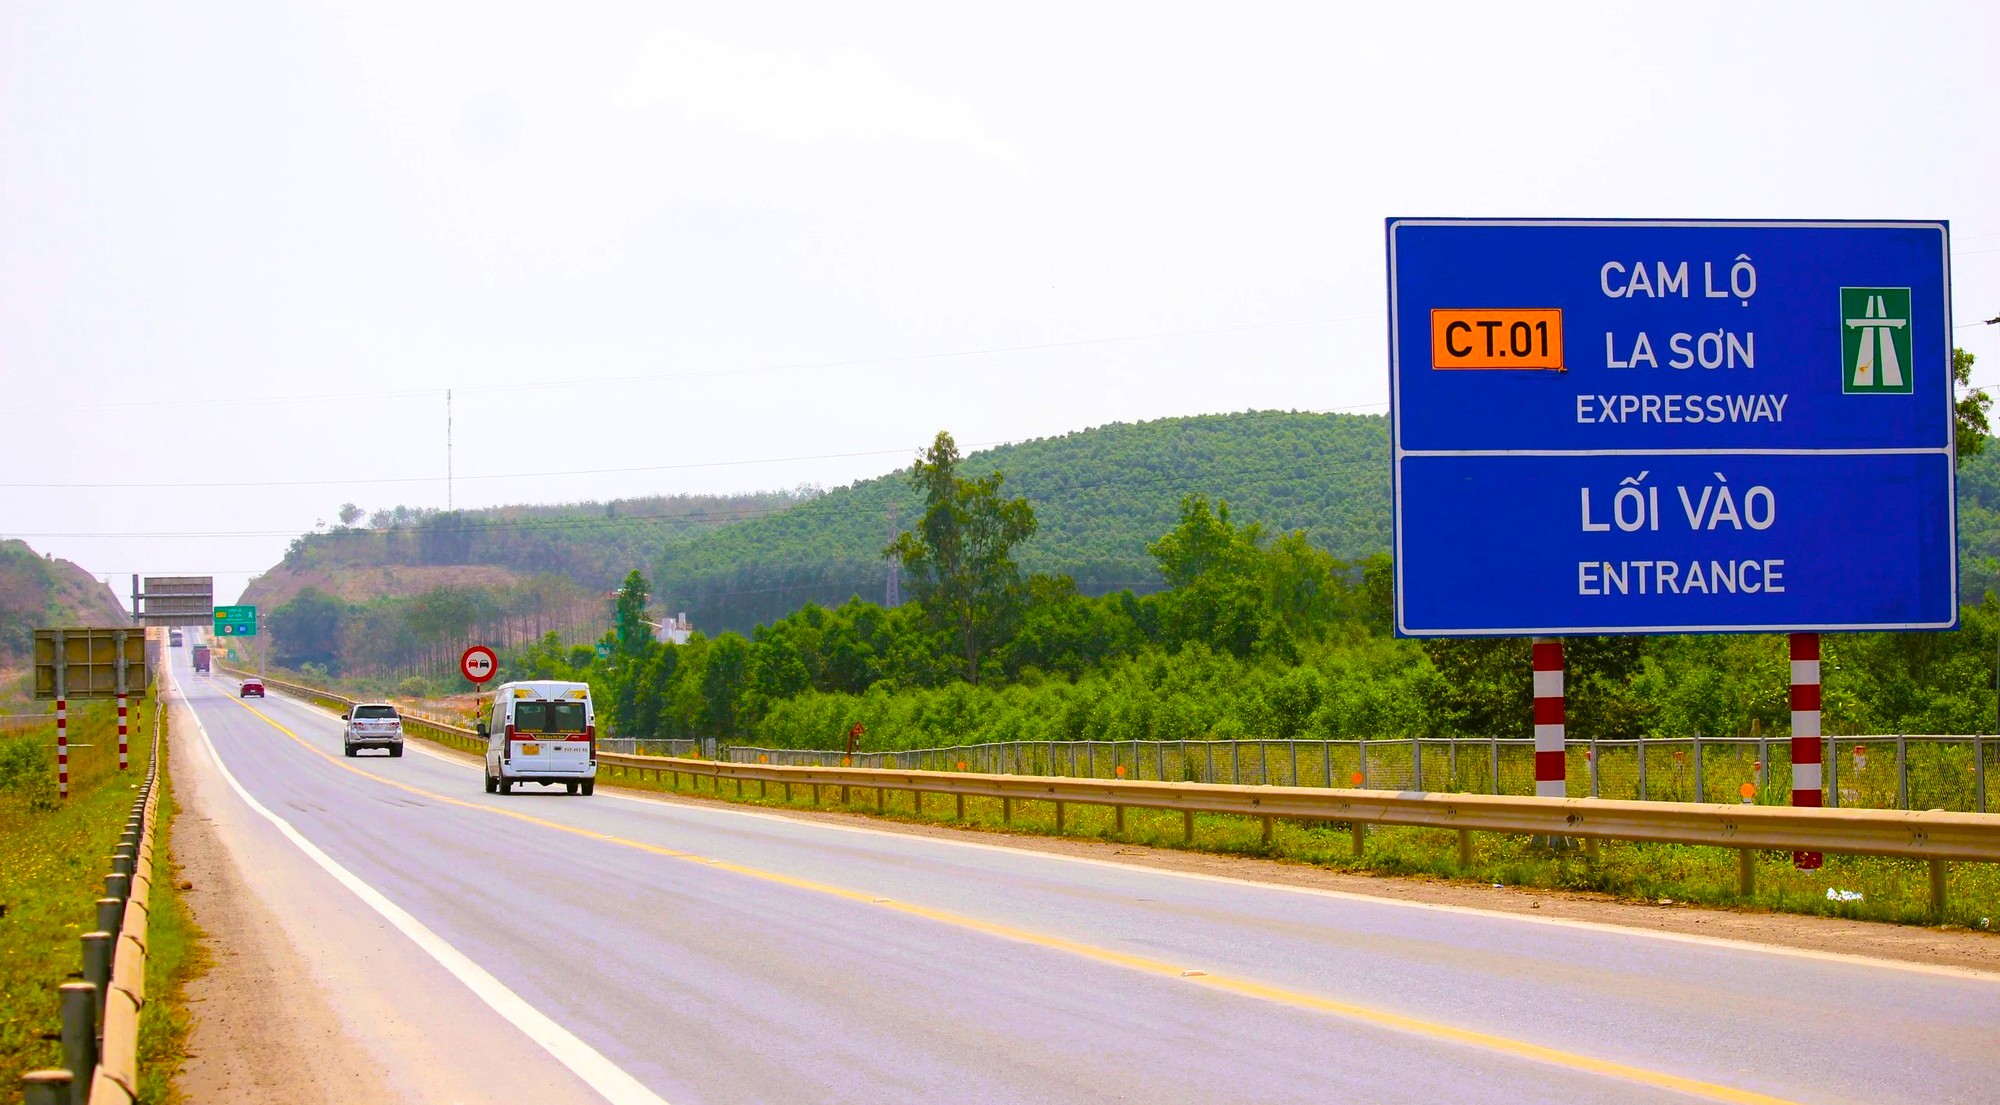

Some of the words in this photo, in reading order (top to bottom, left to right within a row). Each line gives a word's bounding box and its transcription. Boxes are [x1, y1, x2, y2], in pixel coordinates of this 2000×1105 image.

[1600, 261, 1689, 298] CAM
[1704, 253, 1757, 307] LỘ
[1445, 320, 1548, 358] CT.01
[1606, 331, 1659, 369] LA
[1668, 328, 1754, 370] SƠN
[1576, 394, 1789, 423] EXPRESSWAY
[1581, 470, 1659, 532] LỐI
[1677, 472, 1776, 530] VÀO
[1578, 559, 1785, 595] ENTRANCE
